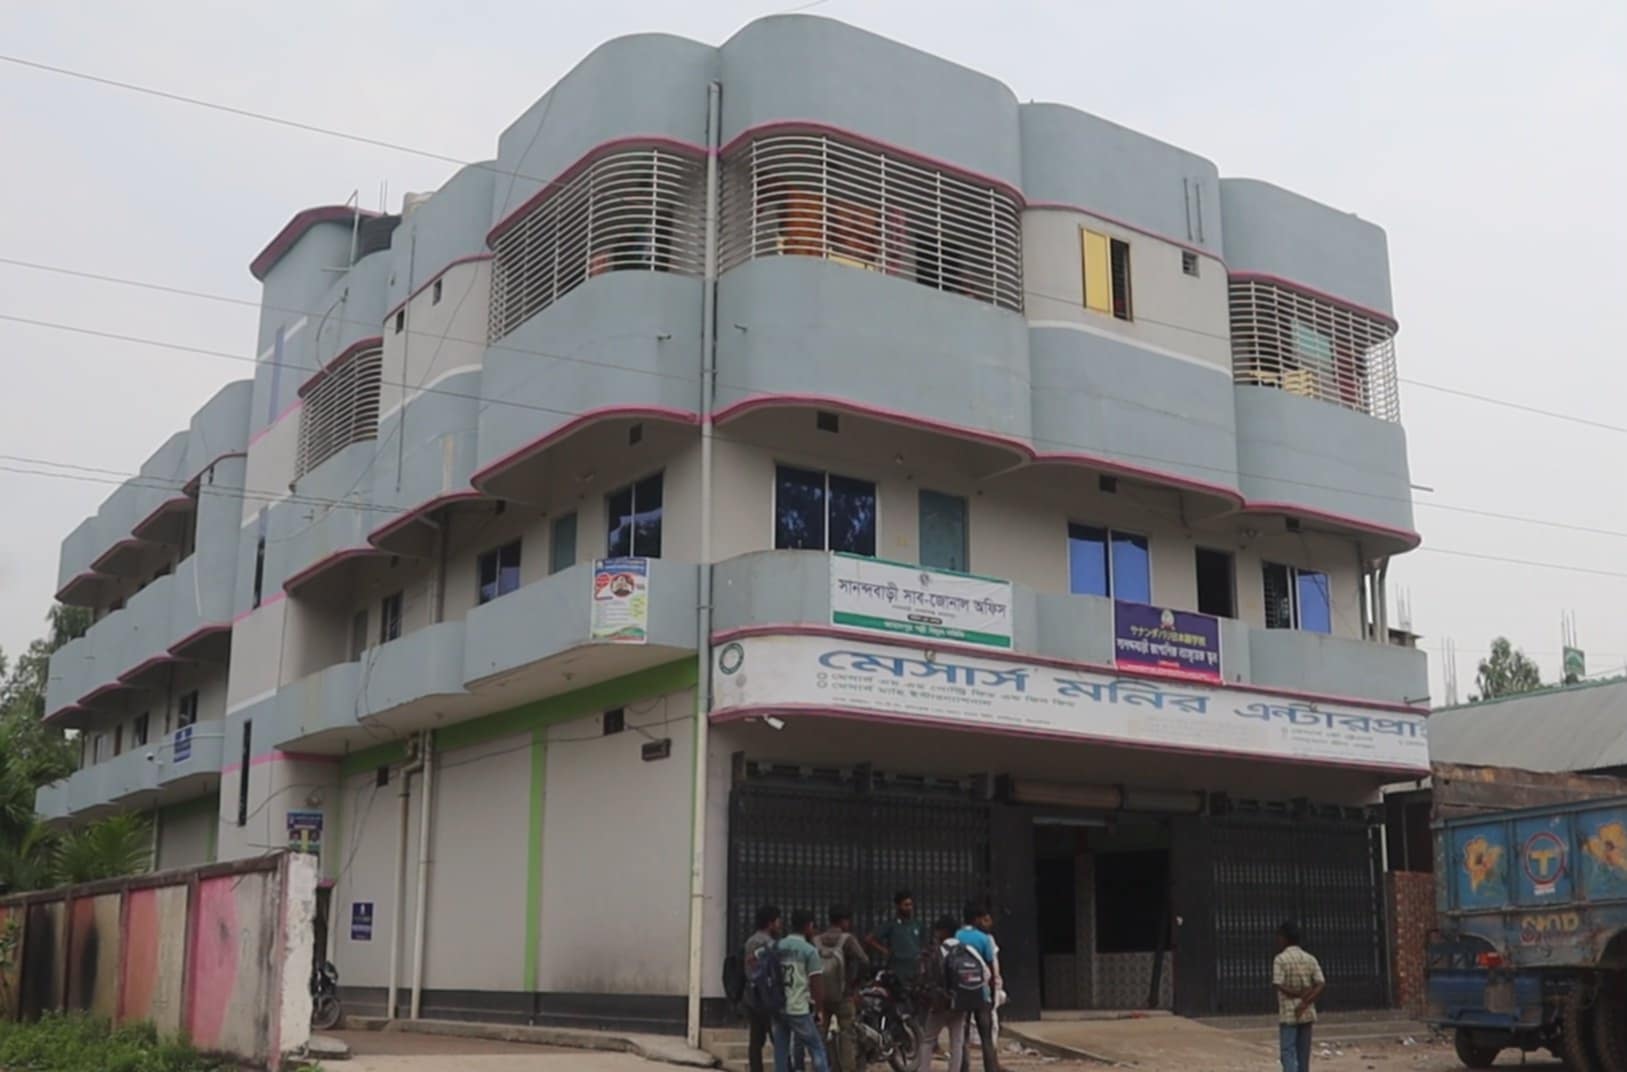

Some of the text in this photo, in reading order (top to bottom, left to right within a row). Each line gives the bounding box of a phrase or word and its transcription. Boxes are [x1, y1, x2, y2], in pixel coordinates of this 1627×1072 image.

[838, 578, 898, 604] সানন্দবাড়ী
[903, 589, 969, 613] সাব-জোনাল
[974, 598, 1006, 617] অফিস
[818, 649, 1030, 693] মেসার্স
[1053, 676, 1210, 715] মনির
